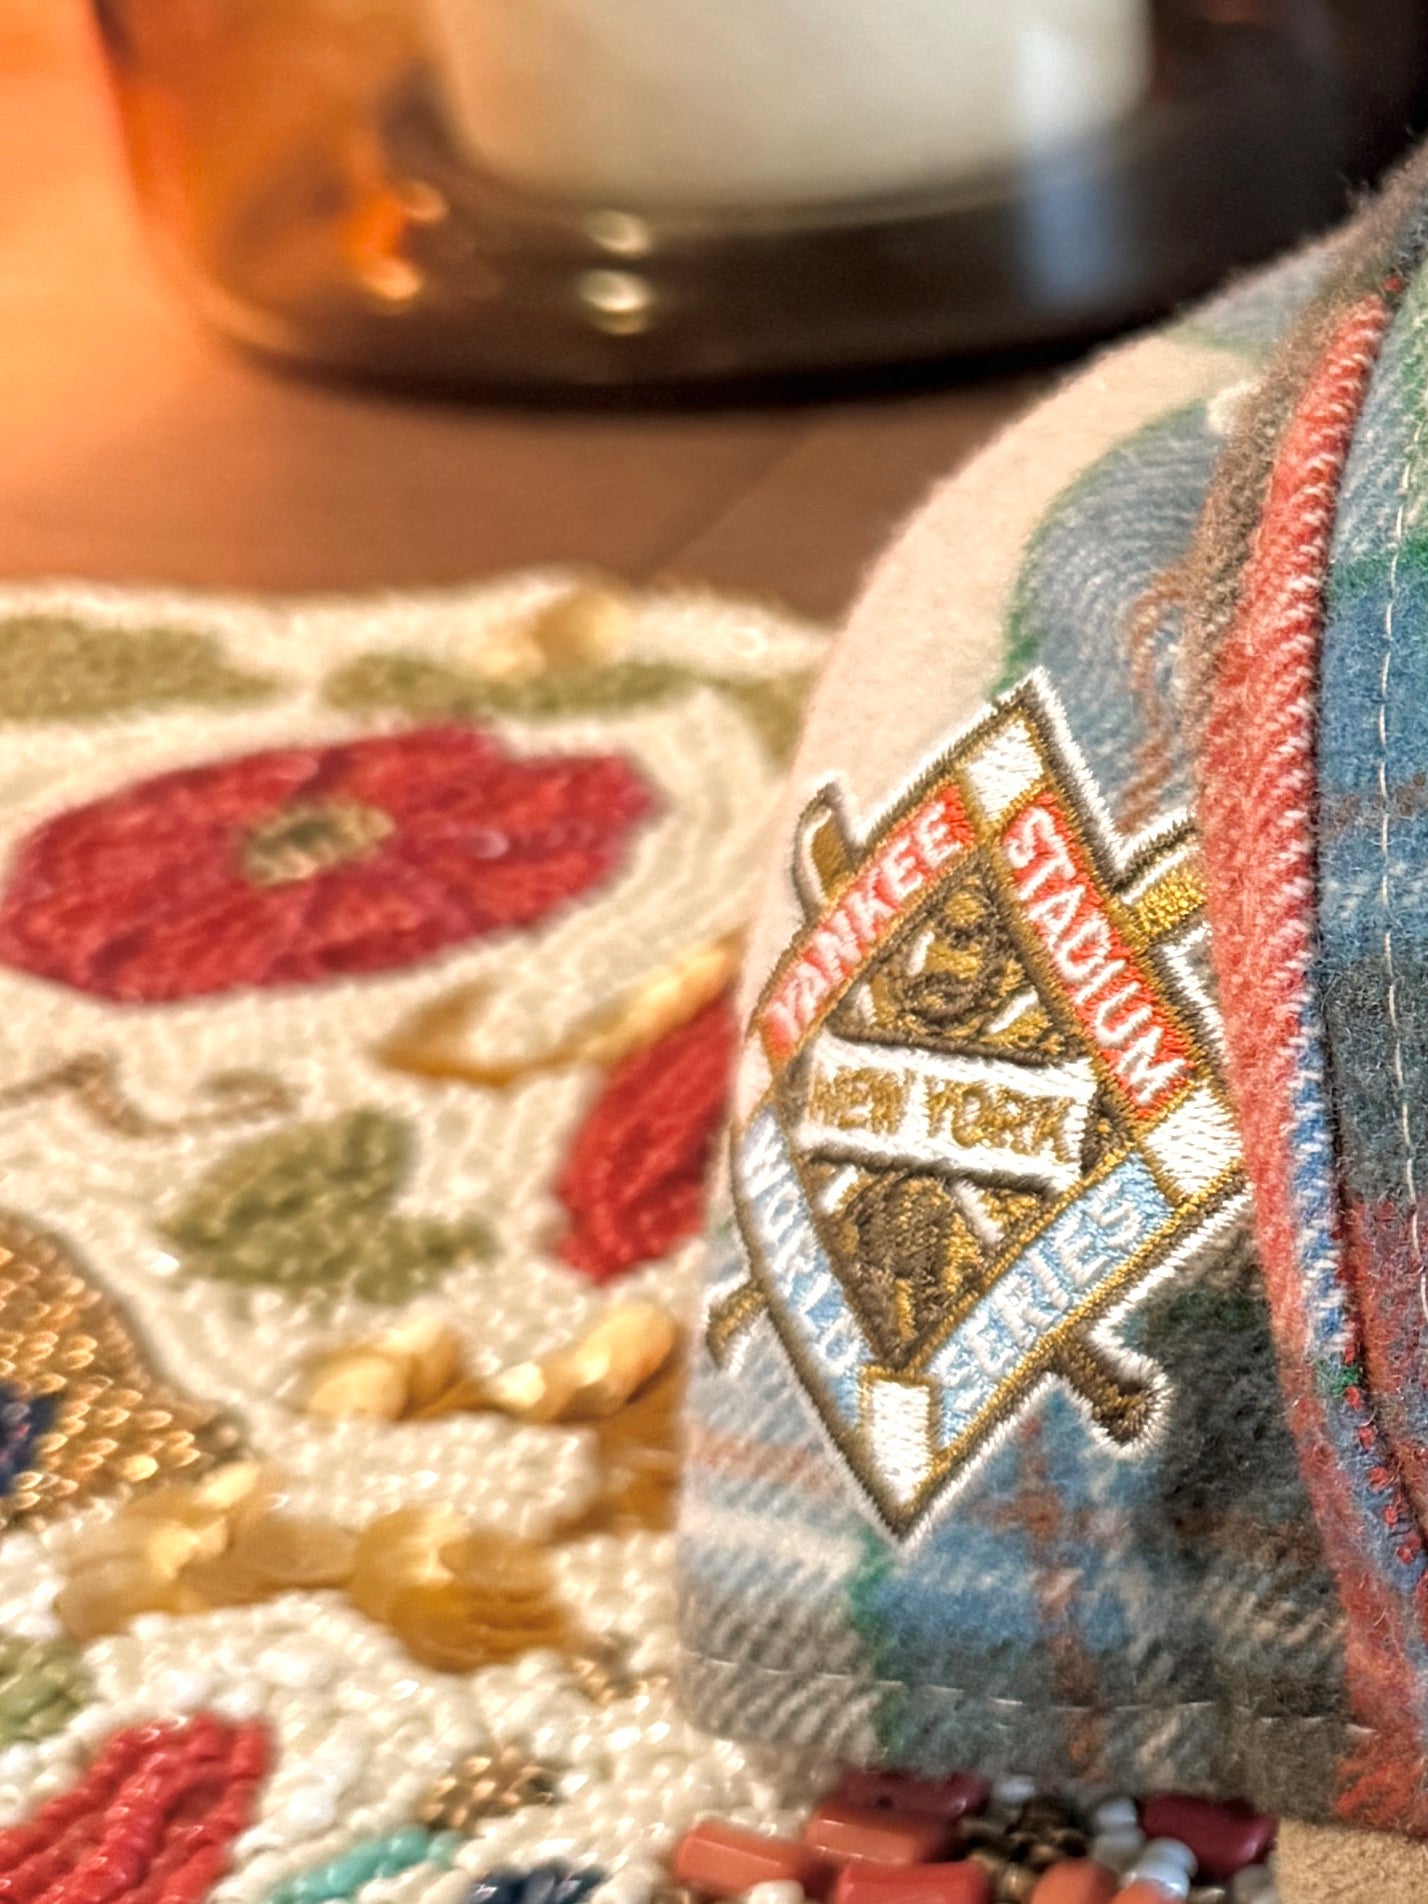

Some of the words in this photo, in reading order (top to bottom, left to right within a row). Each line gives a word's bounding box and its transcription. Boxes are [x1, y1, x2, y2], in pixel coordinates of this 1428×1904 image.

[765, 798, 966, 1045] YANKEE
[1007, 805, 1187, 1105] STADIUM
[921, 1073, 1077, 1165] YORK
[743, 1110, 862, 1379] WORLD
[928, 1181, 1143, 1412] SERIES
